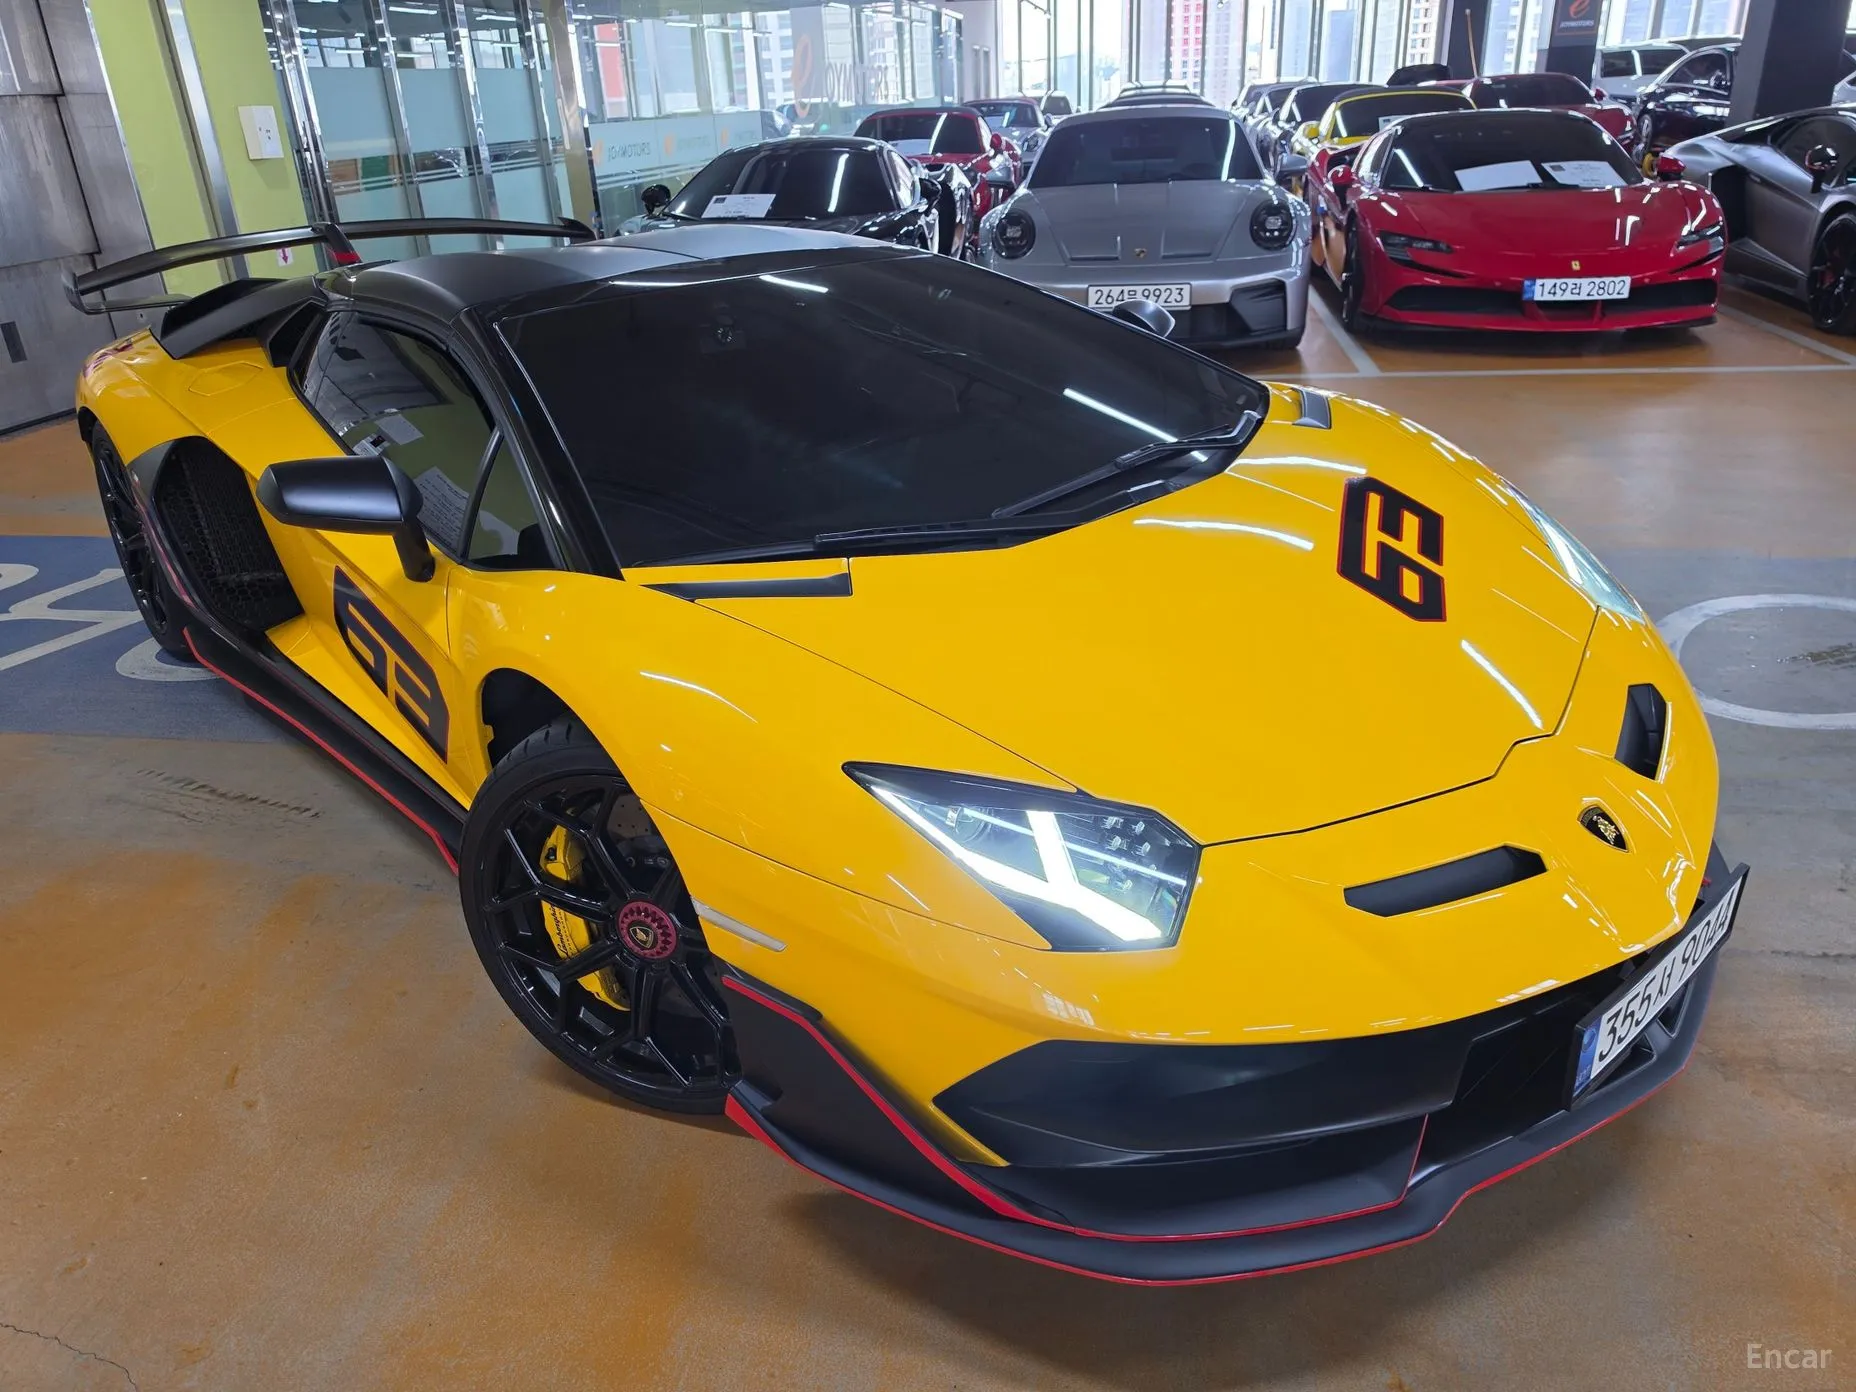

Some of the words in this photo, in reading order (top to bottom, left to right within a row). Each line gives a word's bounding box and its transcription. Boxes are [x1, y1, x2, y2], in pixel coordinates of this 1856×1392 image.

[1141, 287, 1185, 304] 9923
[1586, 279, 1627, 297] 2802
[1336, 476, 1447, 622] 63
[333, 565, 450, 765] 63
[1598, 956, 1676, 1063] 355서
[1679, 888, 1737, 982] 9044
